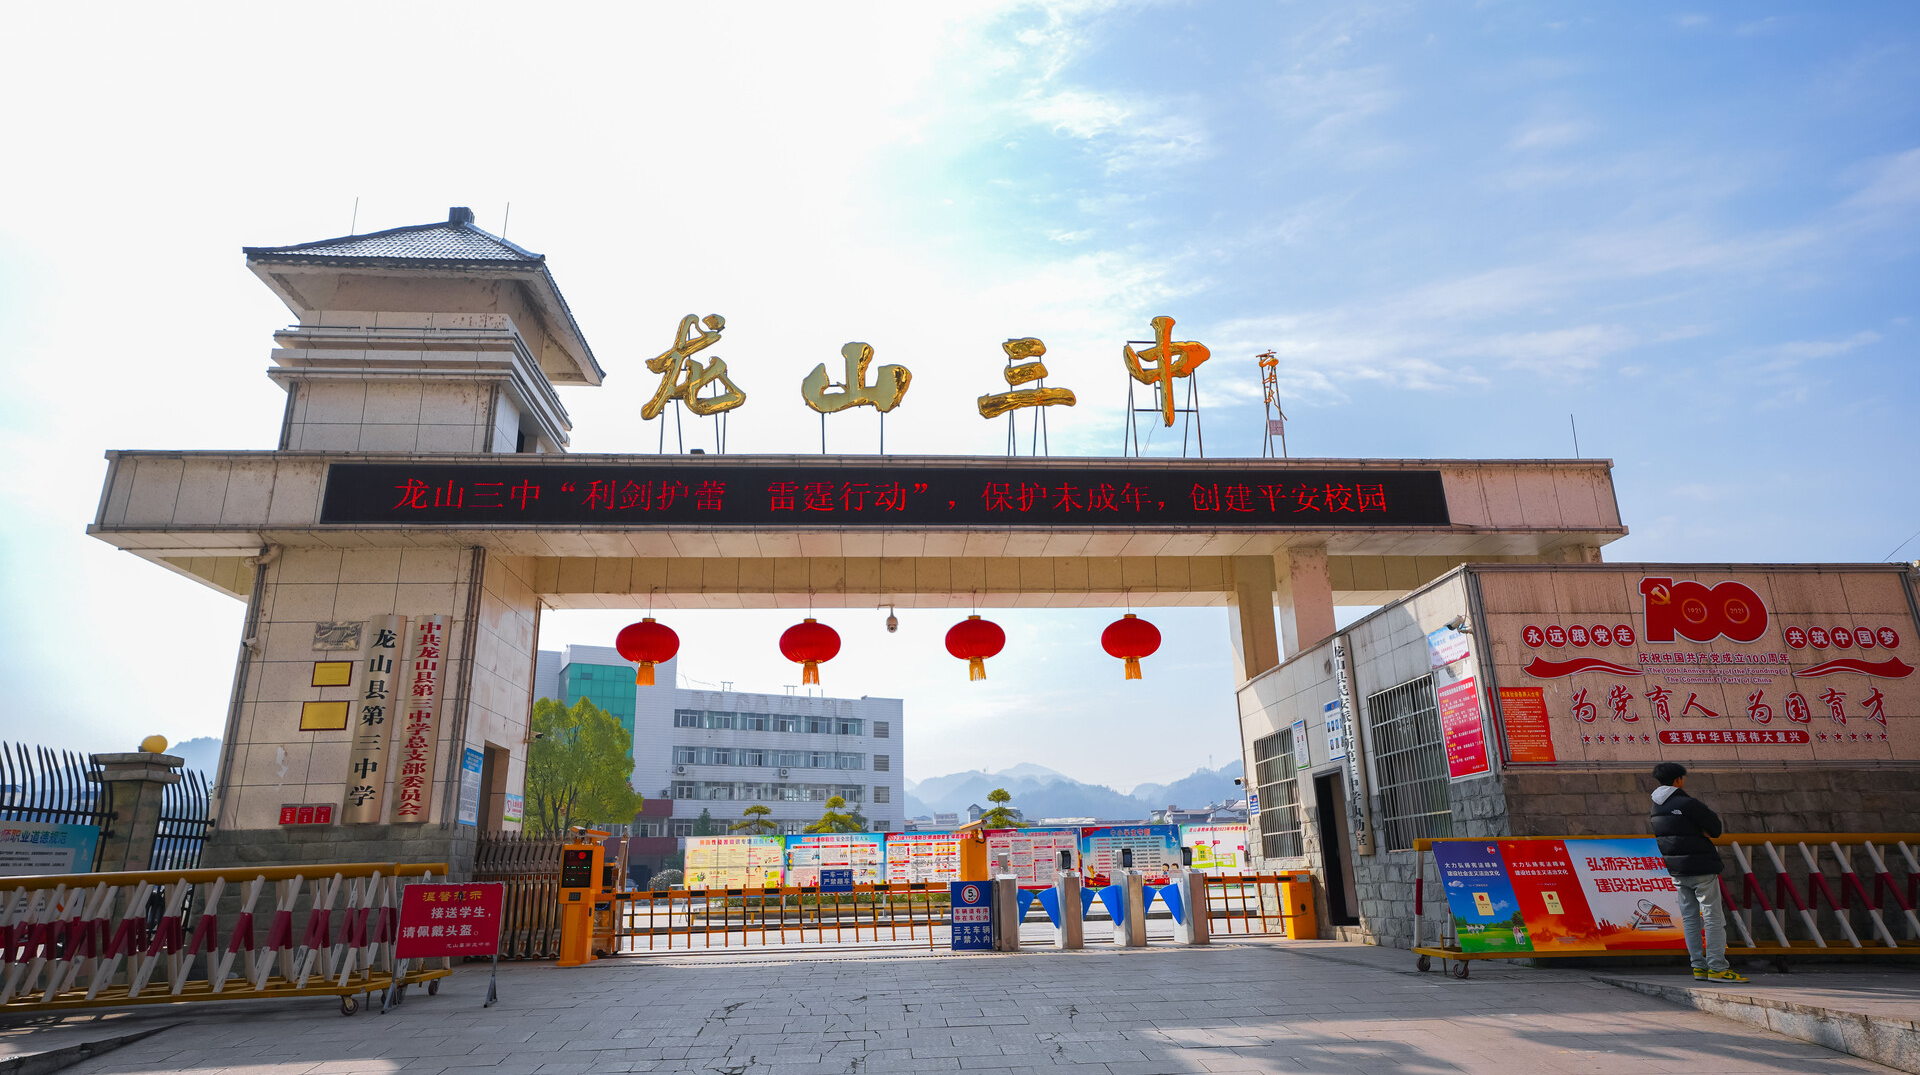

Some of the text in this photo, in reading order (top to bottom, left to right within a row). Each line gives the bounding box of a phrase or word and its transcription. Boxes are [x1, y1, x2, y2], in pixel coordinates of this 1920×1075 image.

[640, 313, 1210, 427] 龙山三中
[392, 478, 726, 512] 龙山三中“利剑护蕾
[1639, 576, 1769, 643] 100
[1729, 607, 1745, 615] 2021
[1526, 627, 1632, 644] 永远跟党走
[1788, 629, 1896, 646] 共筑中国梦
[1638, 652, 1790, 664] 庆祝中国共产党成立100周年
[1649, 666, 1789, 676] The 100th Anniversary of the Founding of
[1681, 676, 1721, 684] Communist
[1723, 676, 1741, 684] Party
[1743, 676, 1750, 684] of
[1752, 676, 1773, 684] China
[1571, 684, 1888, 726] 为党育人 为国育才
[350, 628, 396, 807] 龙山县第三中学
[397, 621, 442, 816] 中共龙山县第三中学总支部委员会
[1669, 731, 1801, 744] 实现中华民族伟大复兴
[0, 829, 69, 845] 师职业道德规范
[1444, 861, 1498, 869] 大力弘扬宪法精神
[1446, 869, 1501, 877] 建设社会主义法治文化
[1594, 877, 1678, 893] 建设法治中国
[967, 889, 974, 898] 5
[953, 926, 991, 935] 三无车辆
[953, 935, 991, 944] 严禁入内
